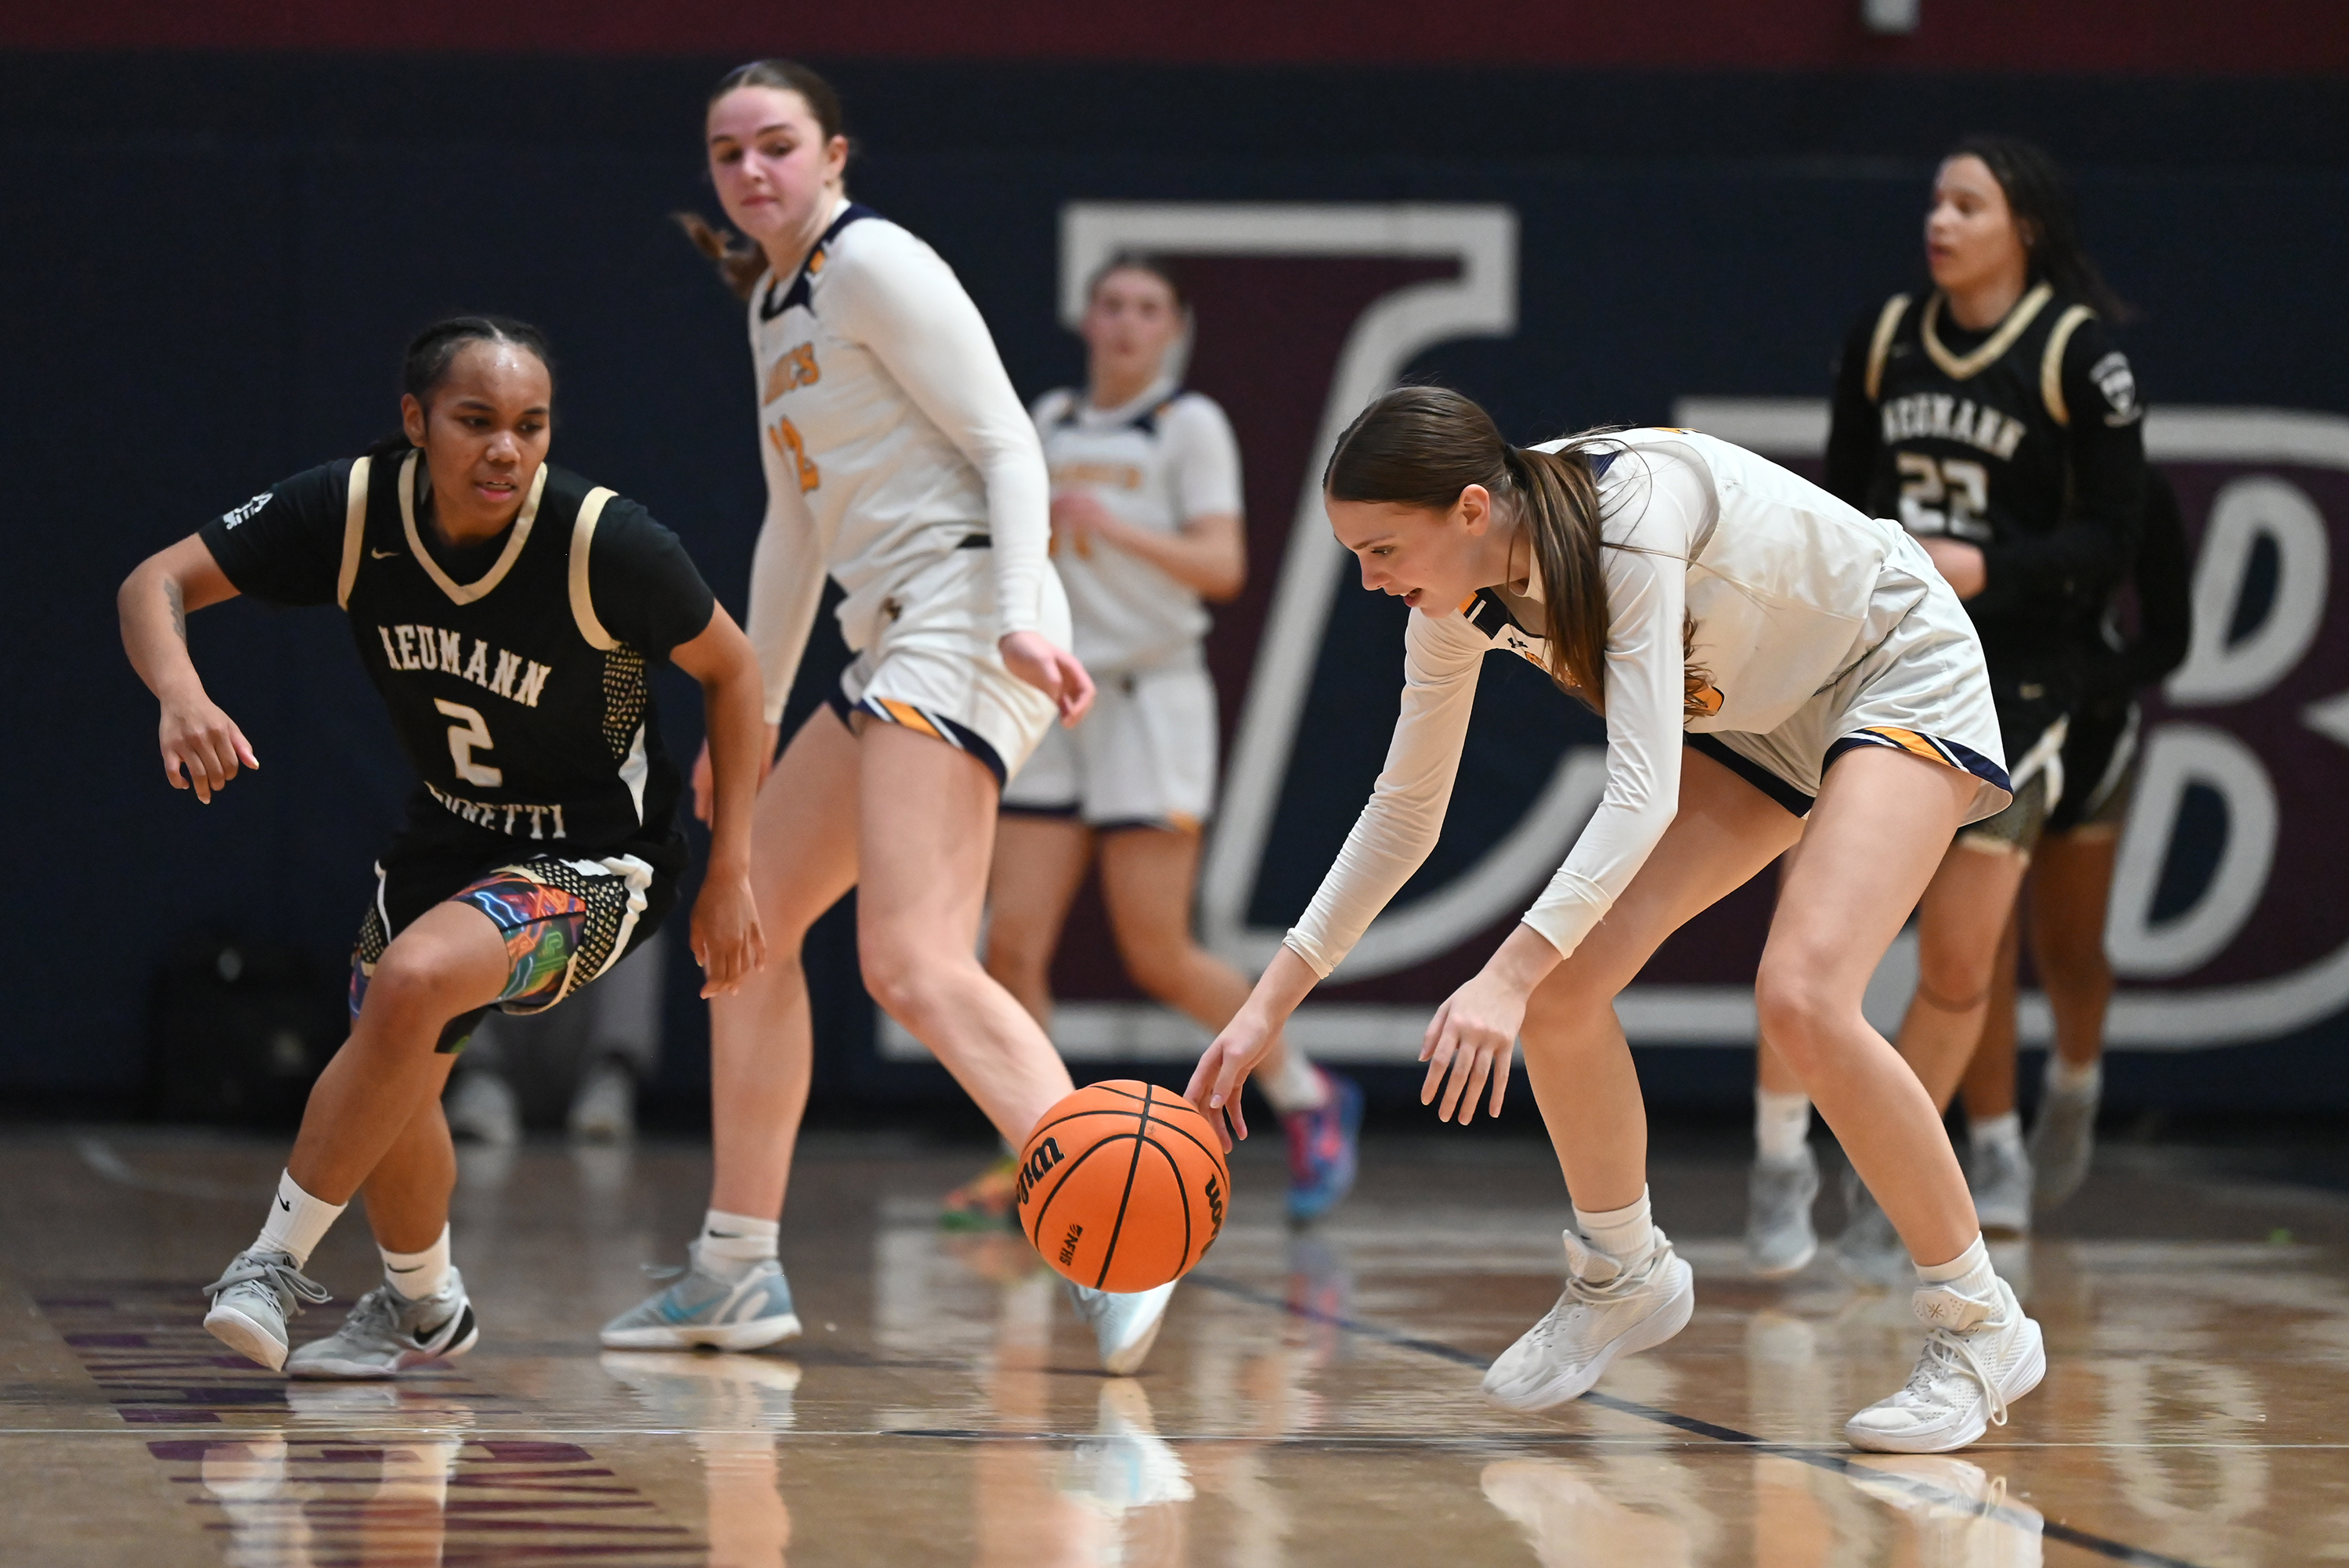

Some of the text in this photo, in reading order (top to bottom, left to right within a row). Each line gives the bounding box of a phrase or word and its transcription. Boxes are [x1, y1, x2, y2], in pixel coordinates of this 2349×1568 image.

[1896, 450, 1994, 540] 22
[433, 697, 503, 788] 2
[1059, 1231, 1080, 1267] NFHS
